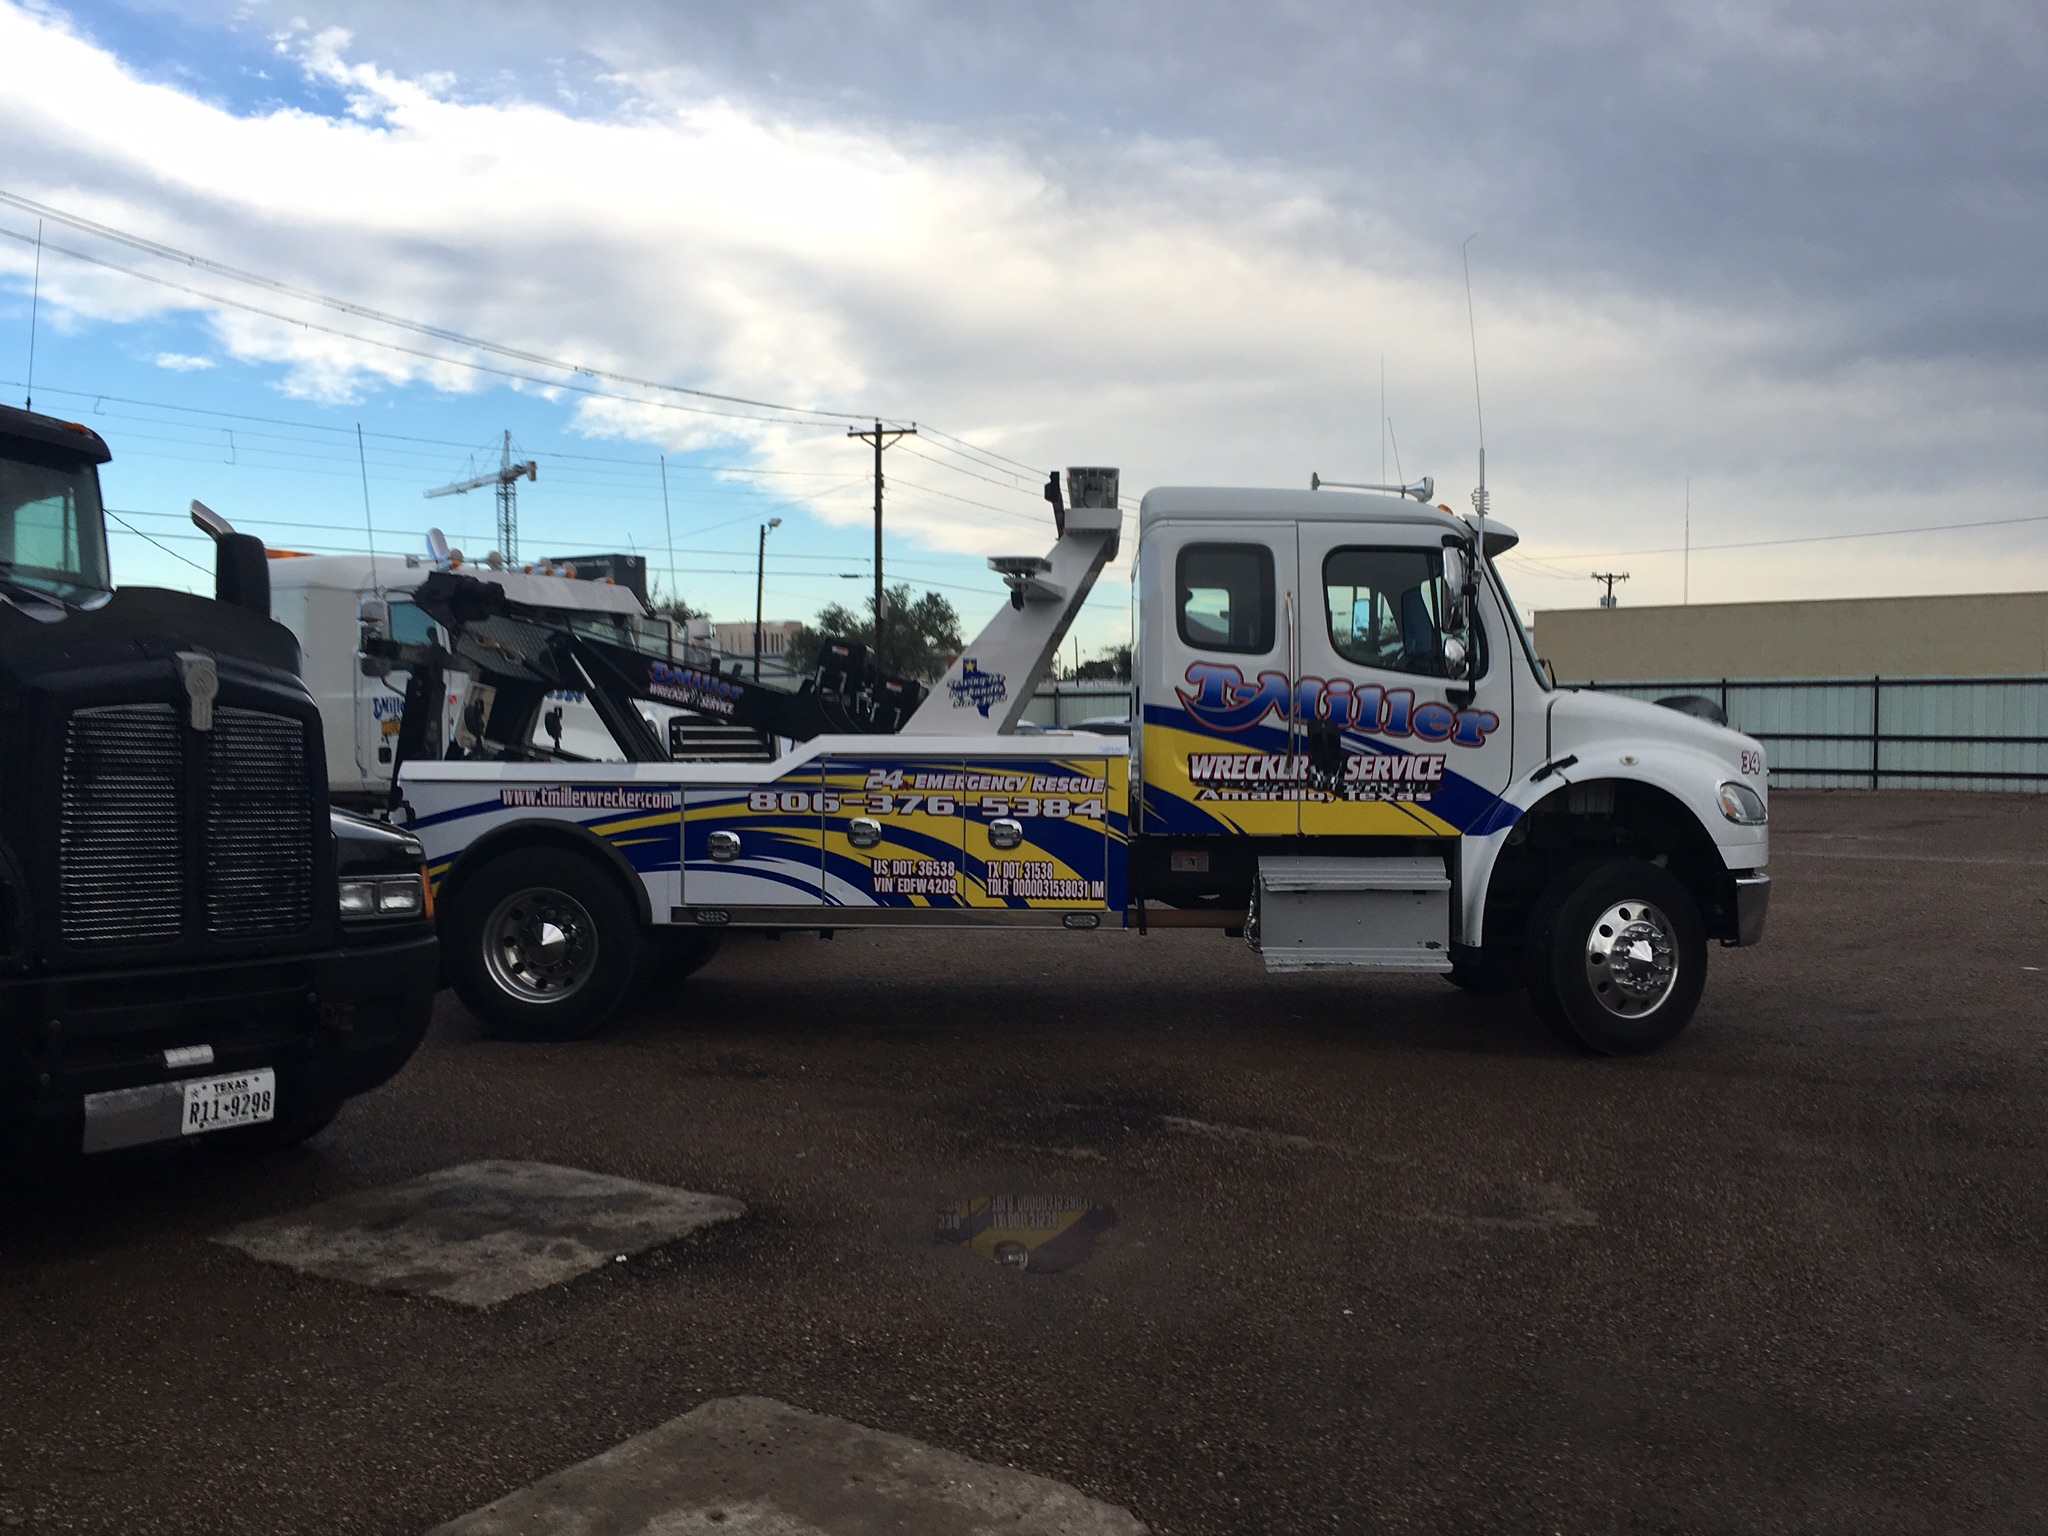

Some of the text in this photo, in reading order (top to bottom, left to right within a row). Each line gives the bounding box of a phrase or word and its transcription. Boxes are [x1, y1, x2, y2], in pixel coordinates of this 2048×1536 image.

[1344, 754, 1445, 781] SERVICE
[914, 773, 1029, 793] EMERGENCY
[1031, 776, 1106, 794] RESCUE
[501, 786, 674, 809] www.tmillerwrecker.com
[748, 791, 1106, 819] 806-376-5384
[1344, 790, 1432, 802] Texas
[873, 859, 956, 877] US DOT 36538
[986, 861, 1053, 880] TX DOT 31538
[873, 877, 957, 894] VIN EDFW4209
[987, 878, 1009, 896] TDLR
[1091, 880, 1105, 898] IM
[213, 1079, 249, 1093] TEXAS
